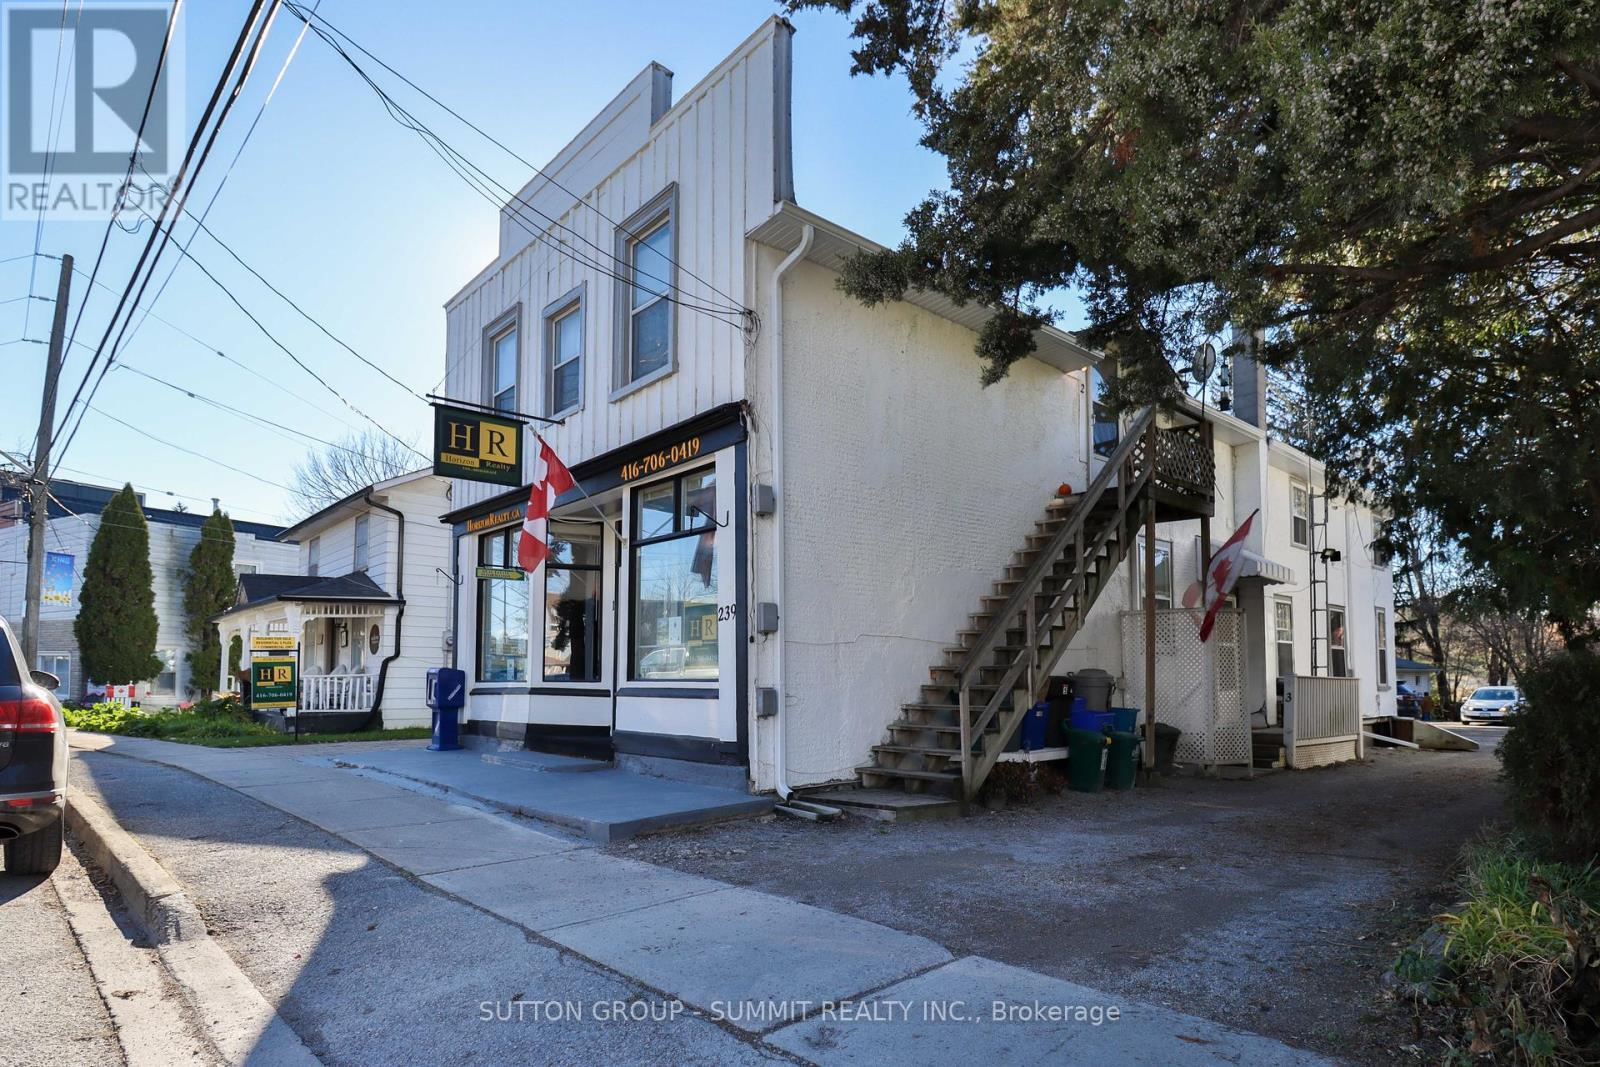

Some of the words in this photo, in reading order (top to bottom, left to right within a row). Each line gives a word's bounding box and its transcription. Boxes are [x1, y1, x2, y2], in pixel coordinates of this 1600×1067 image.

[1080, 383, 1085, 393] 2
[448, 421, 475, 451] H
[487, 428, 509, 457] R
[445, 454, 475, 466] Horizon
[486, 460, 512, 473] Realty
[621, 437, 700, 480] 416-706-0419
[718, 604, 736, 622] 239
[1285, 692, 1292, 703] 3
